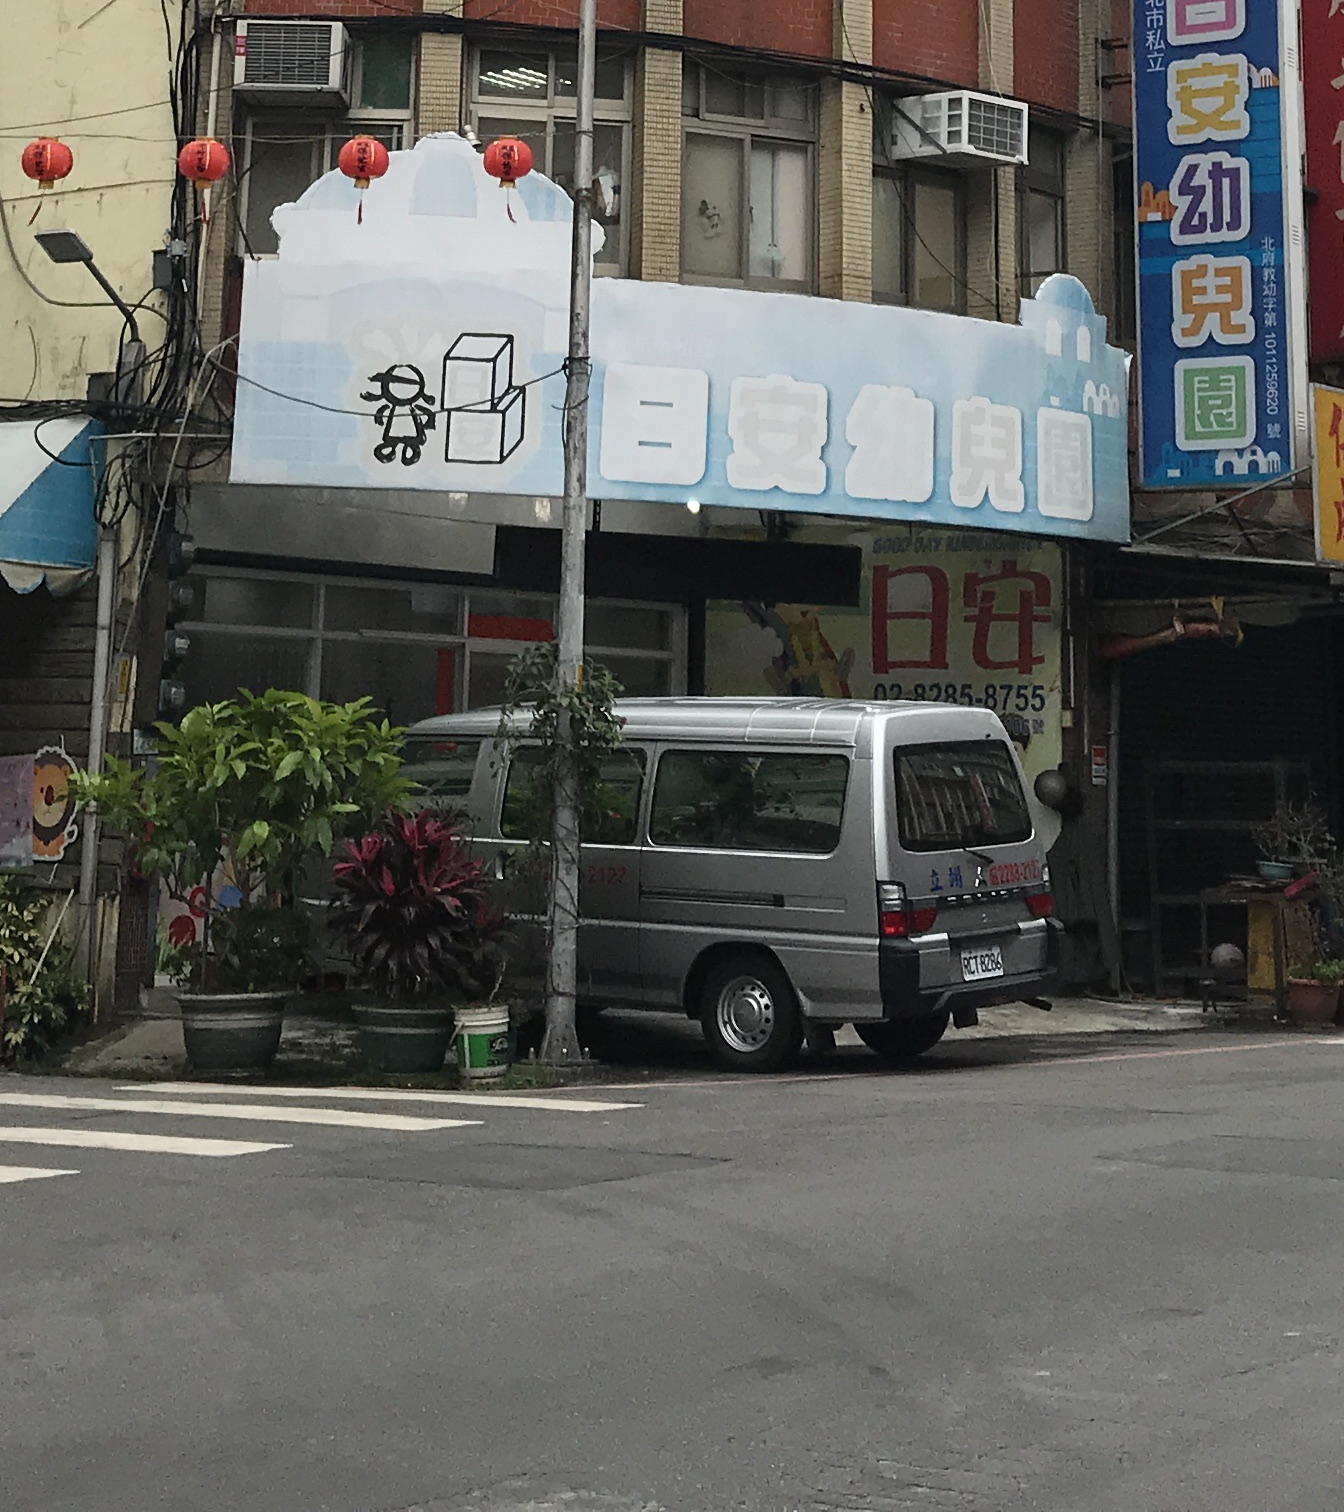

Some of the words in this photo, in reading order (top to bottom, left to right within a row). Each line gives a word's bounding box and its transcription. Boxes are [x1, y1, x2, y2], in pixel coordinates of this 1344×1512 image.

[1264, 331, 1279, 415] 1011259620
[872, 560, 1052, 675] 日安
[873, 683, 1045, 712] 02-8285-8755
